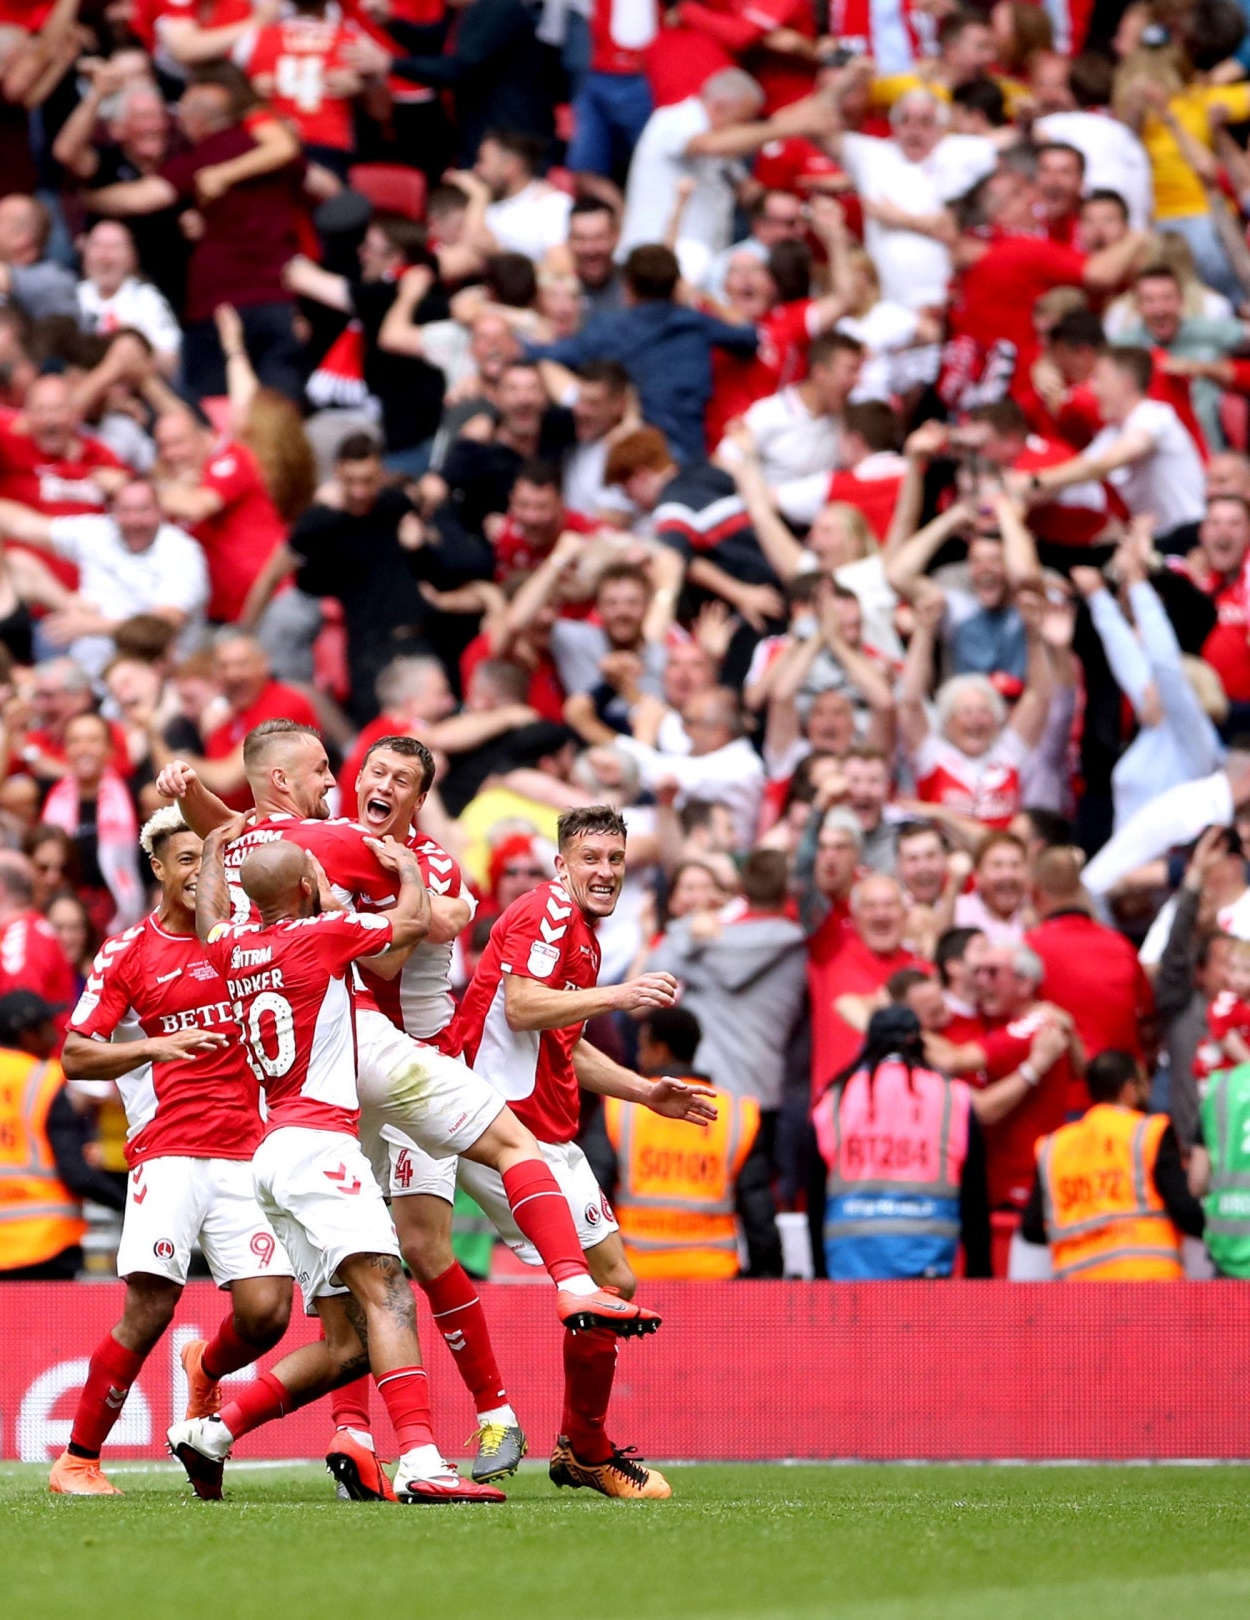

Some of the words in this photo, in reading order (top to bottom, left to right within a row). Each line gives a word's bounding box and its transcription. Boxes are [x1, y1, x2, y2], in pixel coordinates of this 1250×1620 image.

[227, 968, 285, 1000] PARKER
[232, 991, 297, 1081] 10
[394, 1149, 414, 1188] 4
[250, 1232, 276, 1270] 9
